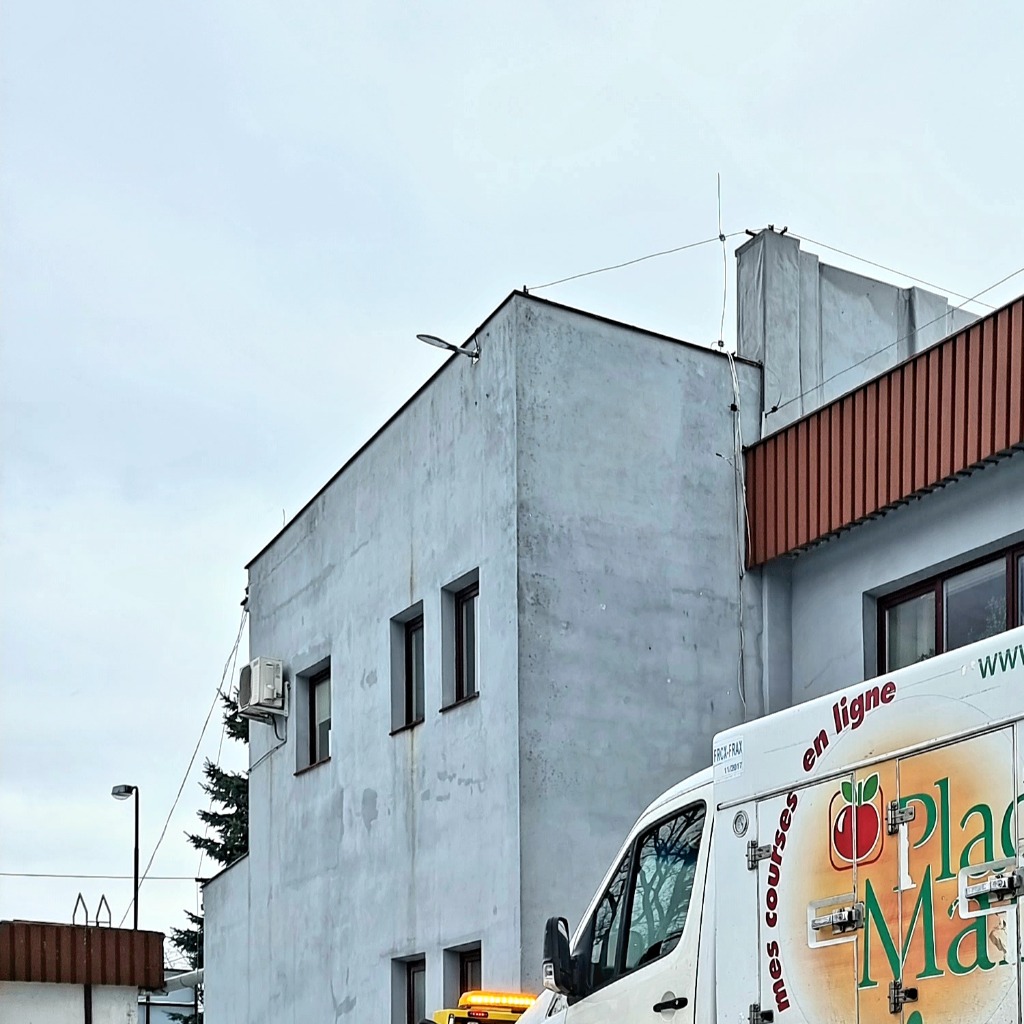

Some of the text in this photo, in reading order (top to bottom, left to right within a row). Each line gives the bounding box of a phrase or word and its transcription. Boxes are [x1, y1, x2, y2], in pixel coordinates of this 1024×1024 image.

[765, 681, 897, 1013] mes courses en ligne
